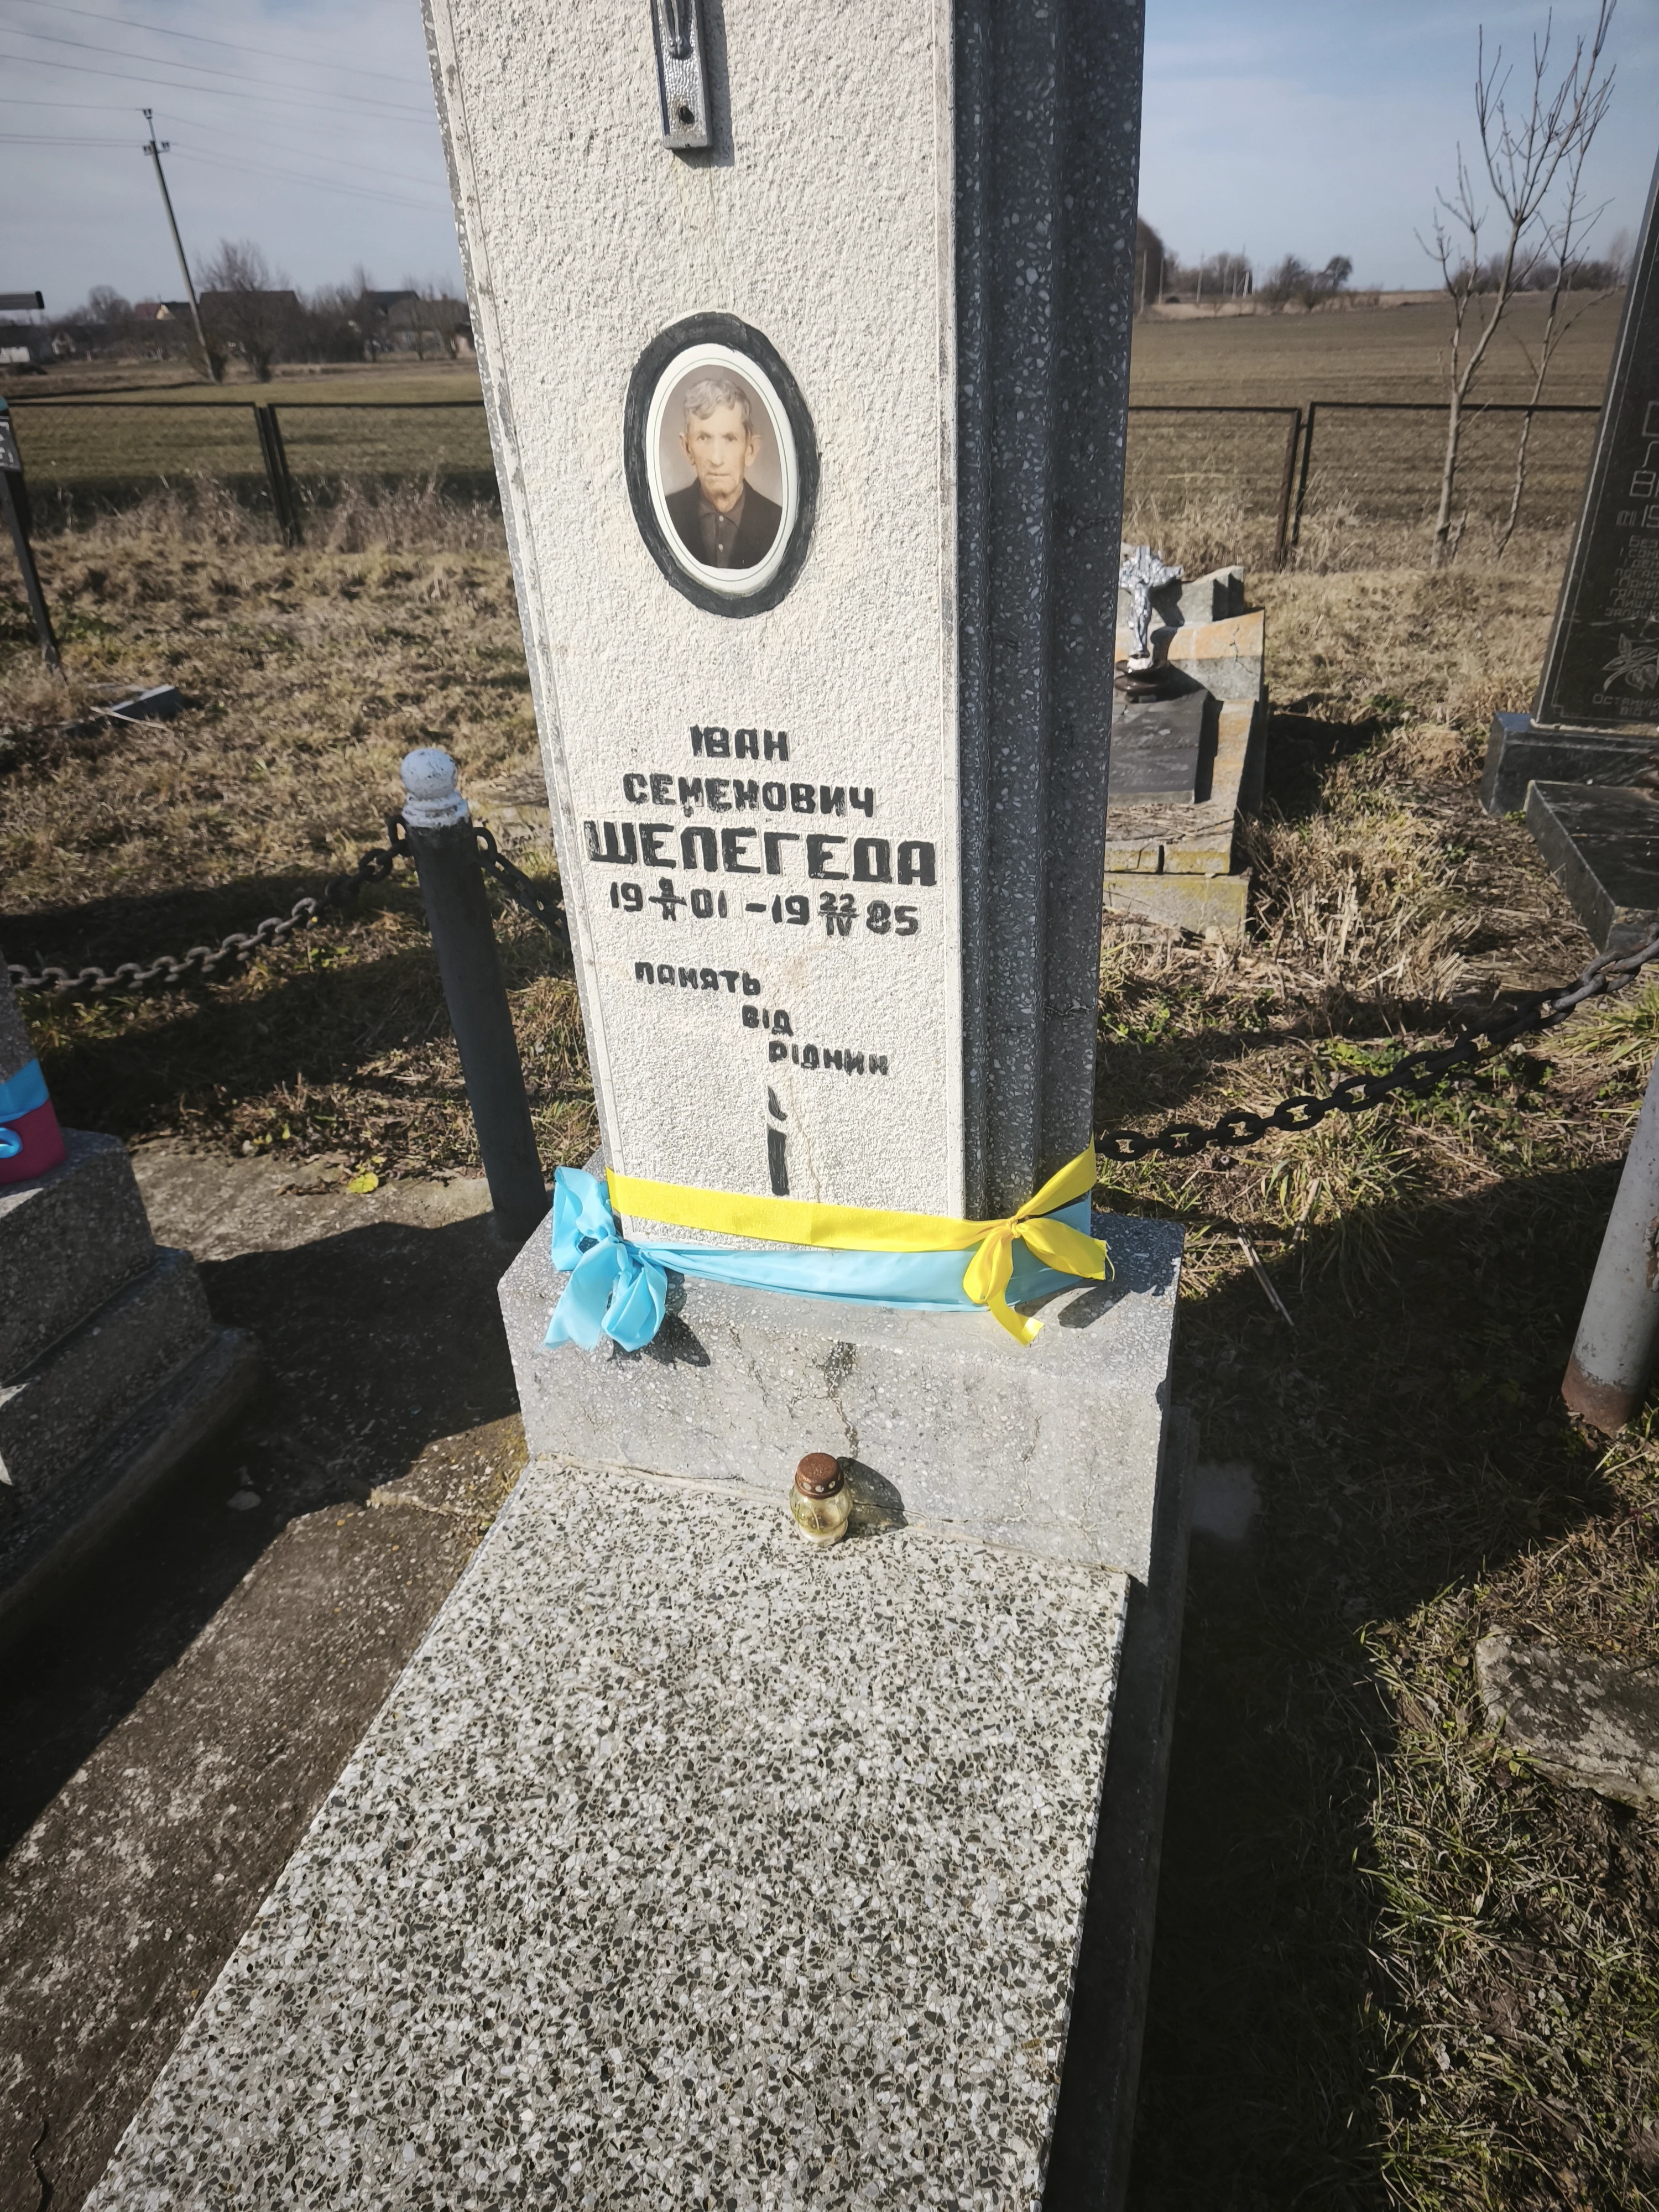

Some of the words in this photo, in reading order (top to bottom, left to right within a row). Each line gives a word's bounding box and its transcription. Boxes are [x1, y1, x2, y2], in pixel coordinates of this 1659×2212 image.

[690, 724, 789, 761] ІВАН
[623, 773, 874, 817] СЕМЕНОВИЧ
[583, 820, 937, 886] ШЕЛЕГЕДА
[866, 902, 919, 936] 85
[635, 962, 761, 996] ПАМЯТЬ
[742, 1005, 794, 1036] ВІД
[769, 1041, 888, 1076] РІДНИХ
